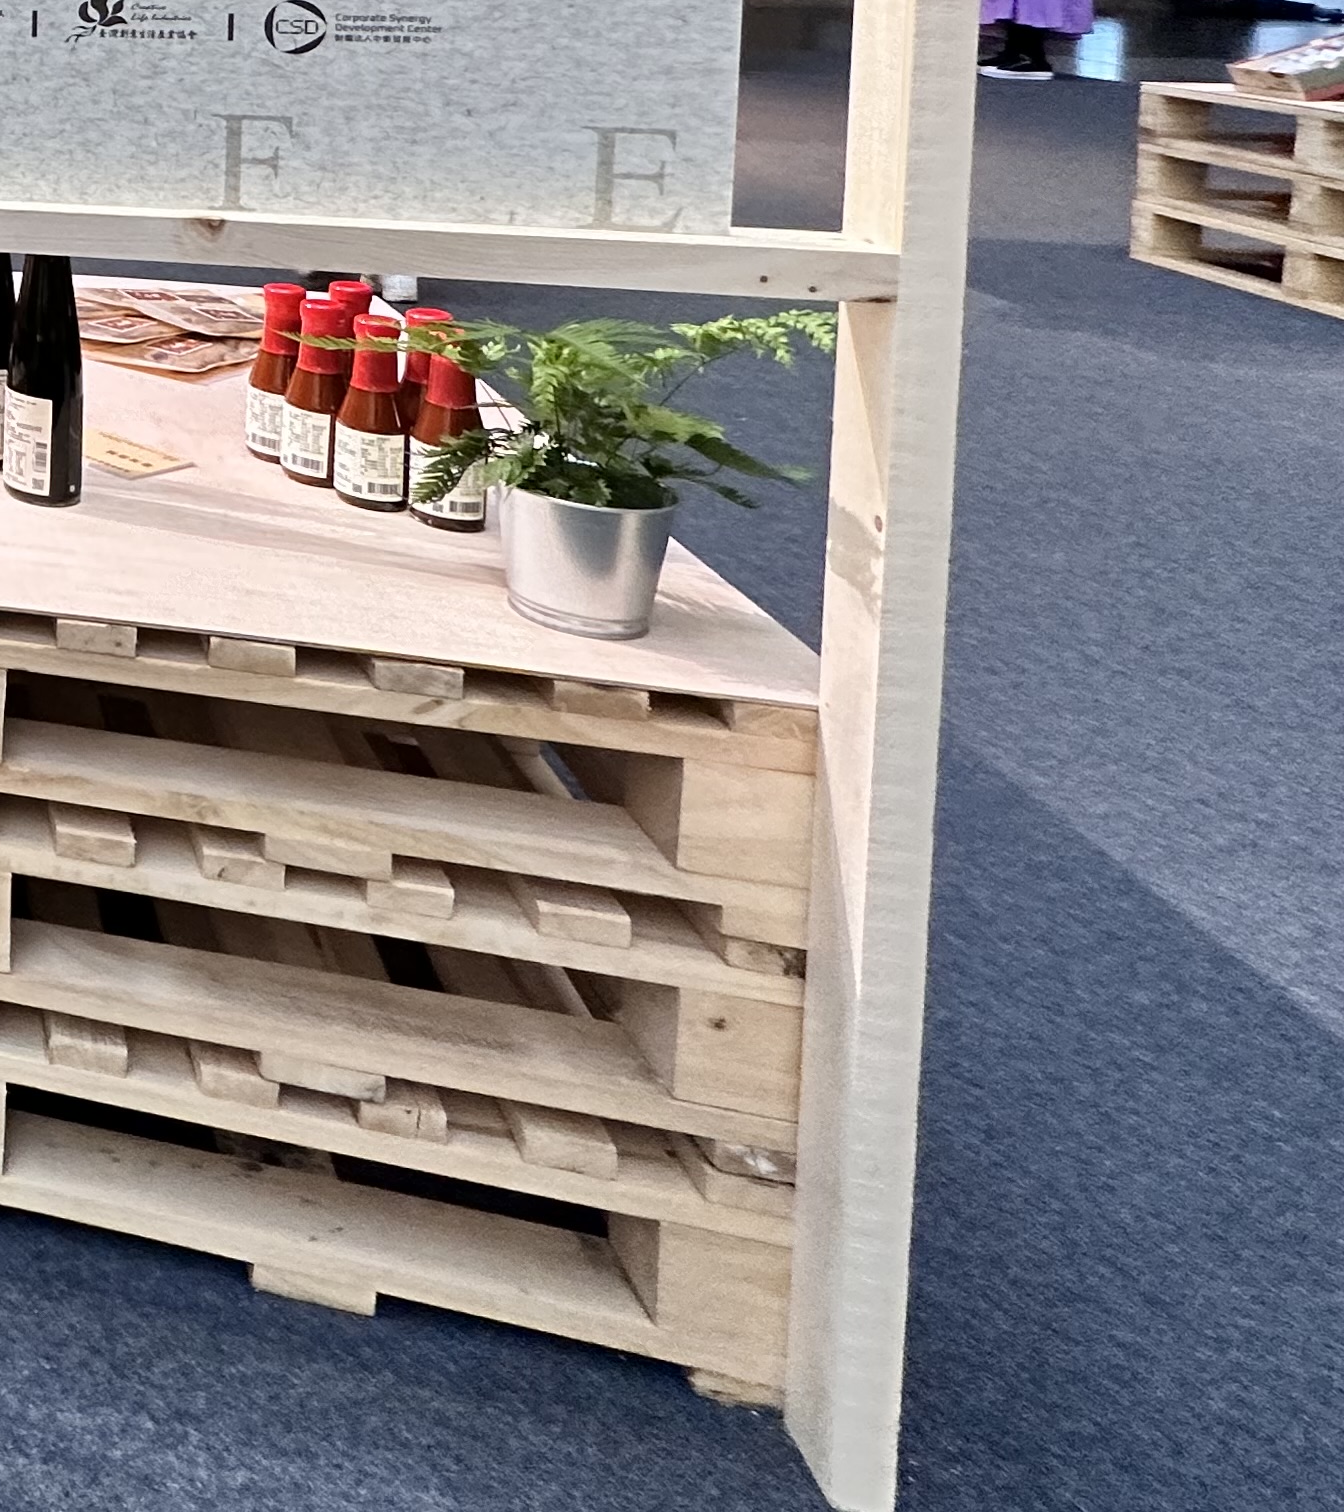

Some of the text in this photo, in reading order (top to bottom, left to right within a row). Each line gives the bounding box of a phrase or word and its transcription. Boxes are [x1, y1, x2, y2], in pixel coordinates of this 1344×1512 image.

[335, 13, 432, 24] Corporate Synergy
[275, 19, 319, 35] CSD
[335, 23, 443, 33] Development Center
